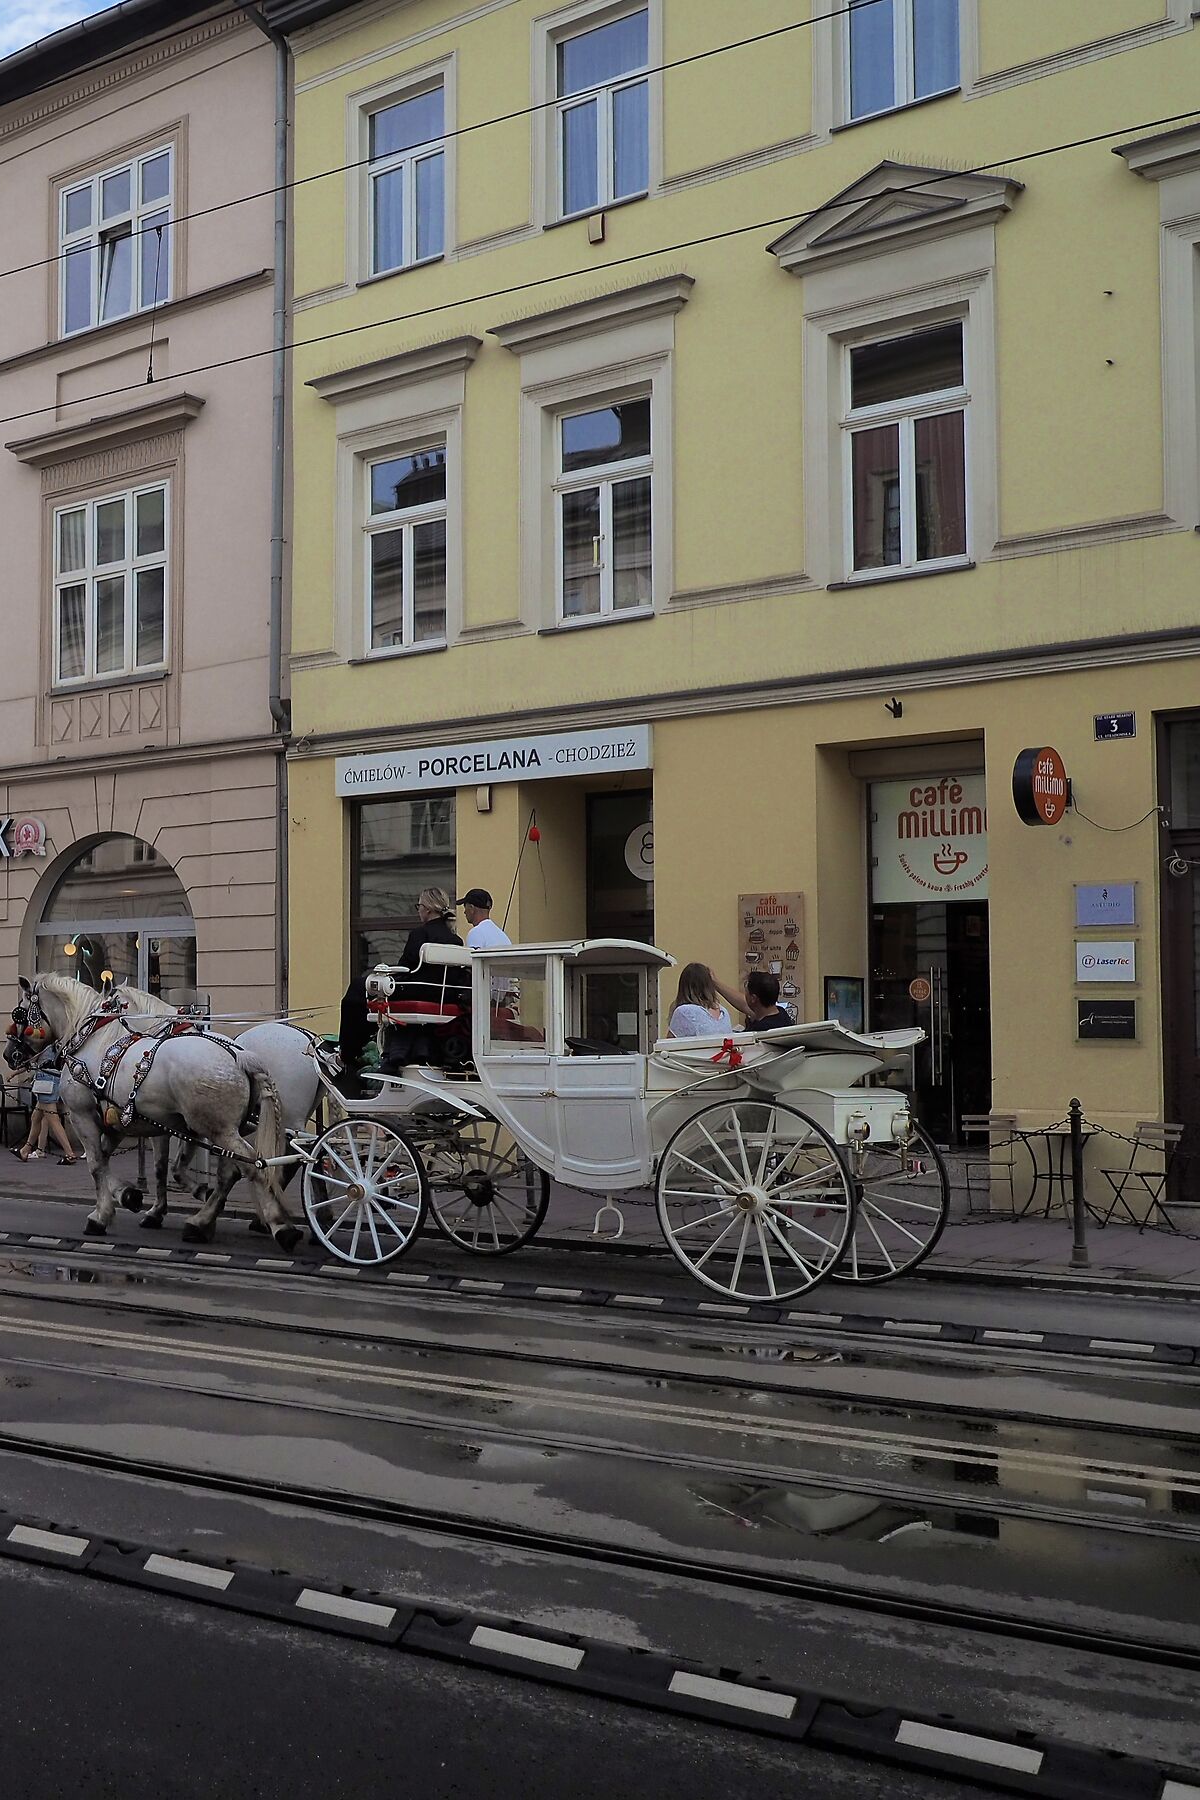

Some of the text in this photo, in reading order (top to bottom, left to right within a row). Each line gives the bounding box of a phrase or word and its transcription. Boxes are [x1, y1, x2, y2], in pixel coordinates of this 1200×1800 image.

[1110, 719, 1118, 732] 3
[418, 748, 541, 777] PORCELANA
[1096, 957, 1130, 965] LaserTec
